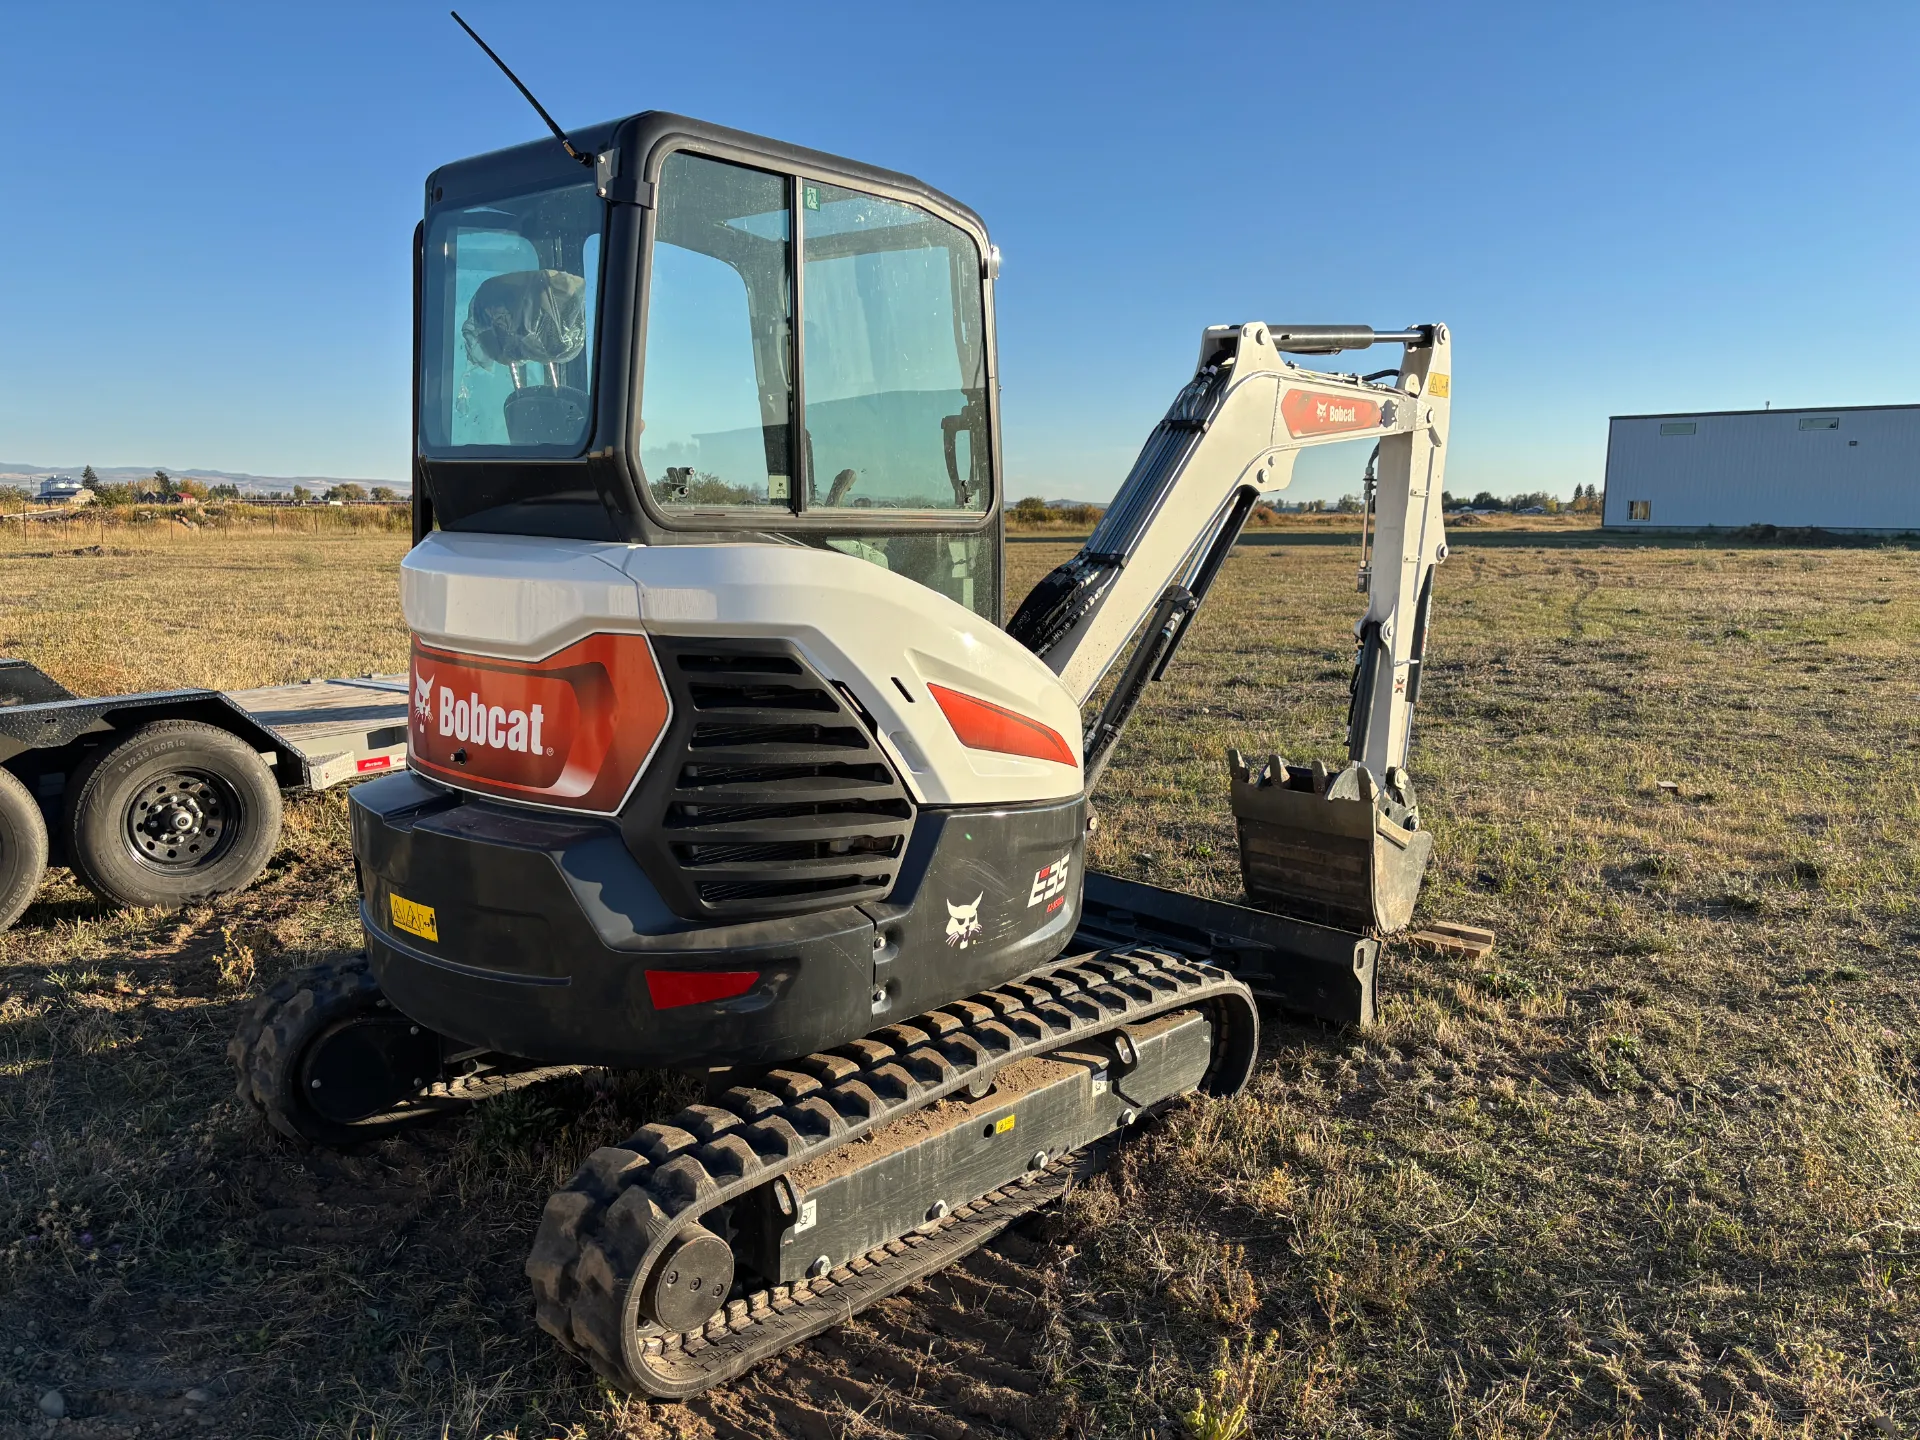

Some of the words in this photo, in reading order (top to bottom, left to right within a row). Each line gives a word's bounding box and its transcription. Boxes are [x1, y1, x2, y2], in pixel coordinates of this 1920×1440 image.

[1329, 405, 1355, 422] Bobcat
[439, 685, 544, 756] Bobcat
[0, 872, 30, 919] ST235/8
[1026, 852, 1070, 908] E35
